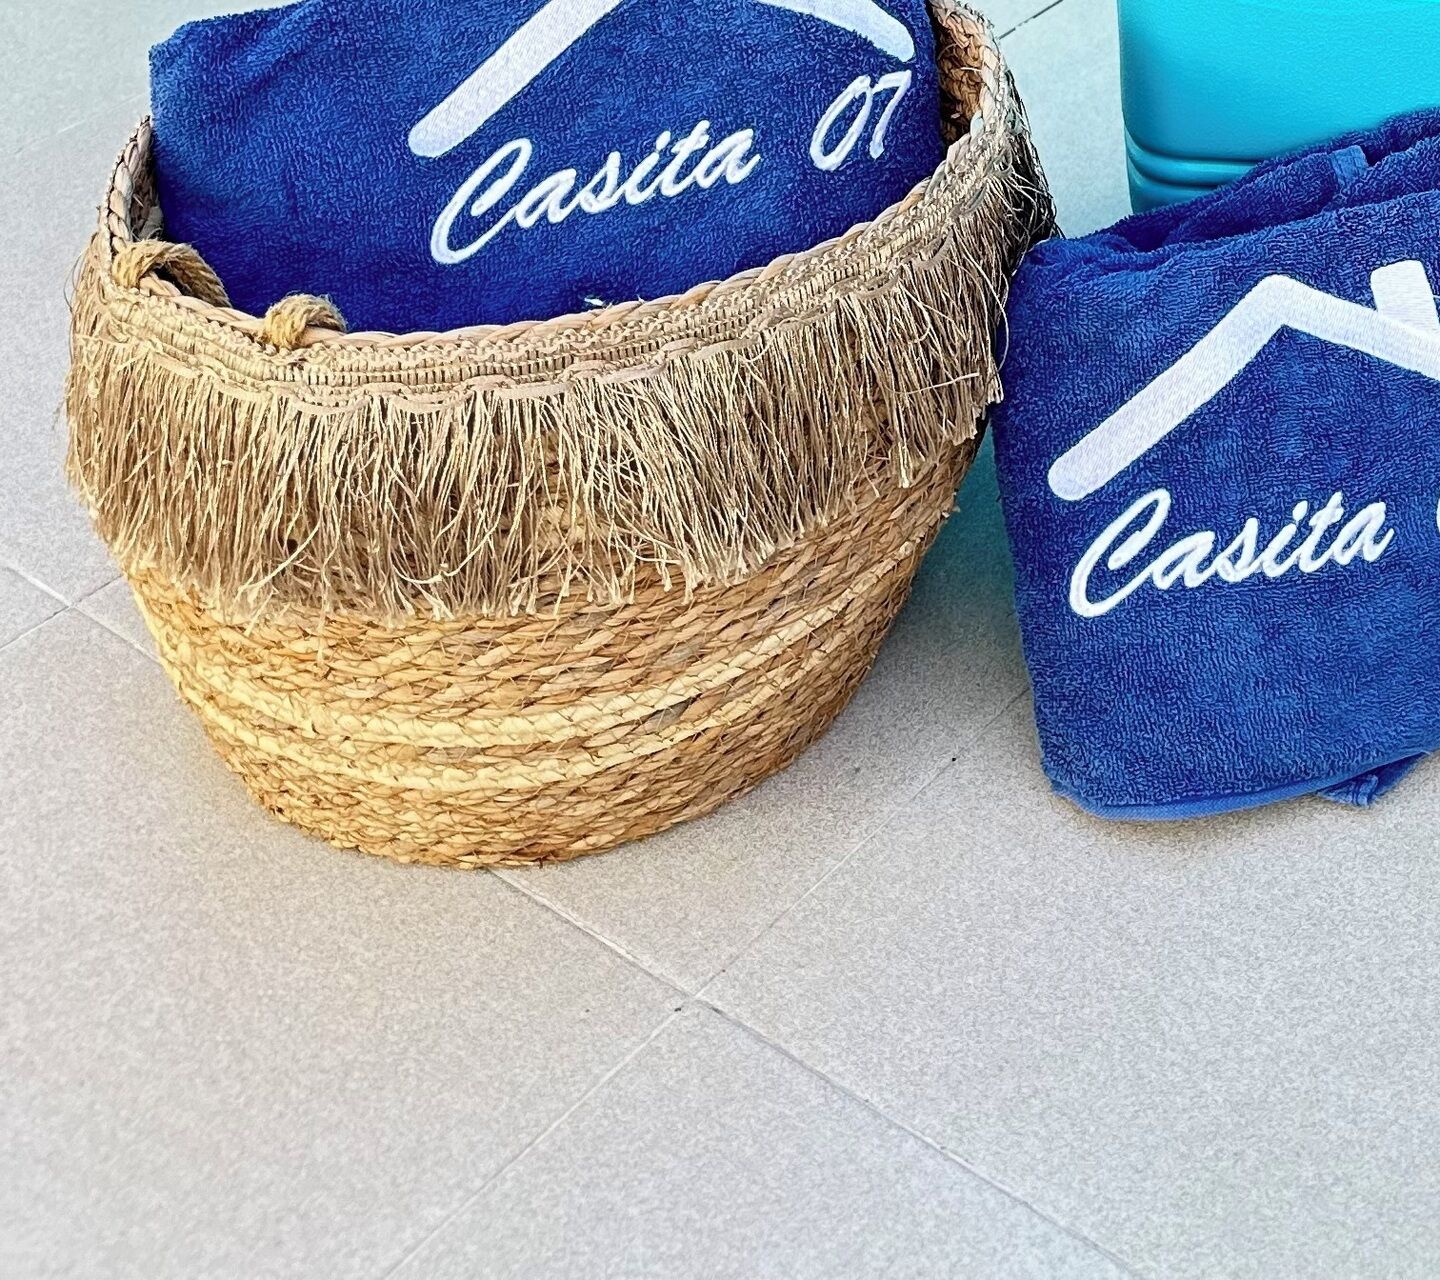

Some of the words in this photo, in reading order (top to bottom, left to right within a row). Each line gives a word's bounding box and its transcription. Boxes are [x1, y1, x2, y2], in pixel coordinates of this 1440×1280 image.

[430, 120, 761, 265] Casita
[808, 69, 912, 171] 07
[1068, 487, 1395, 618] Casita
